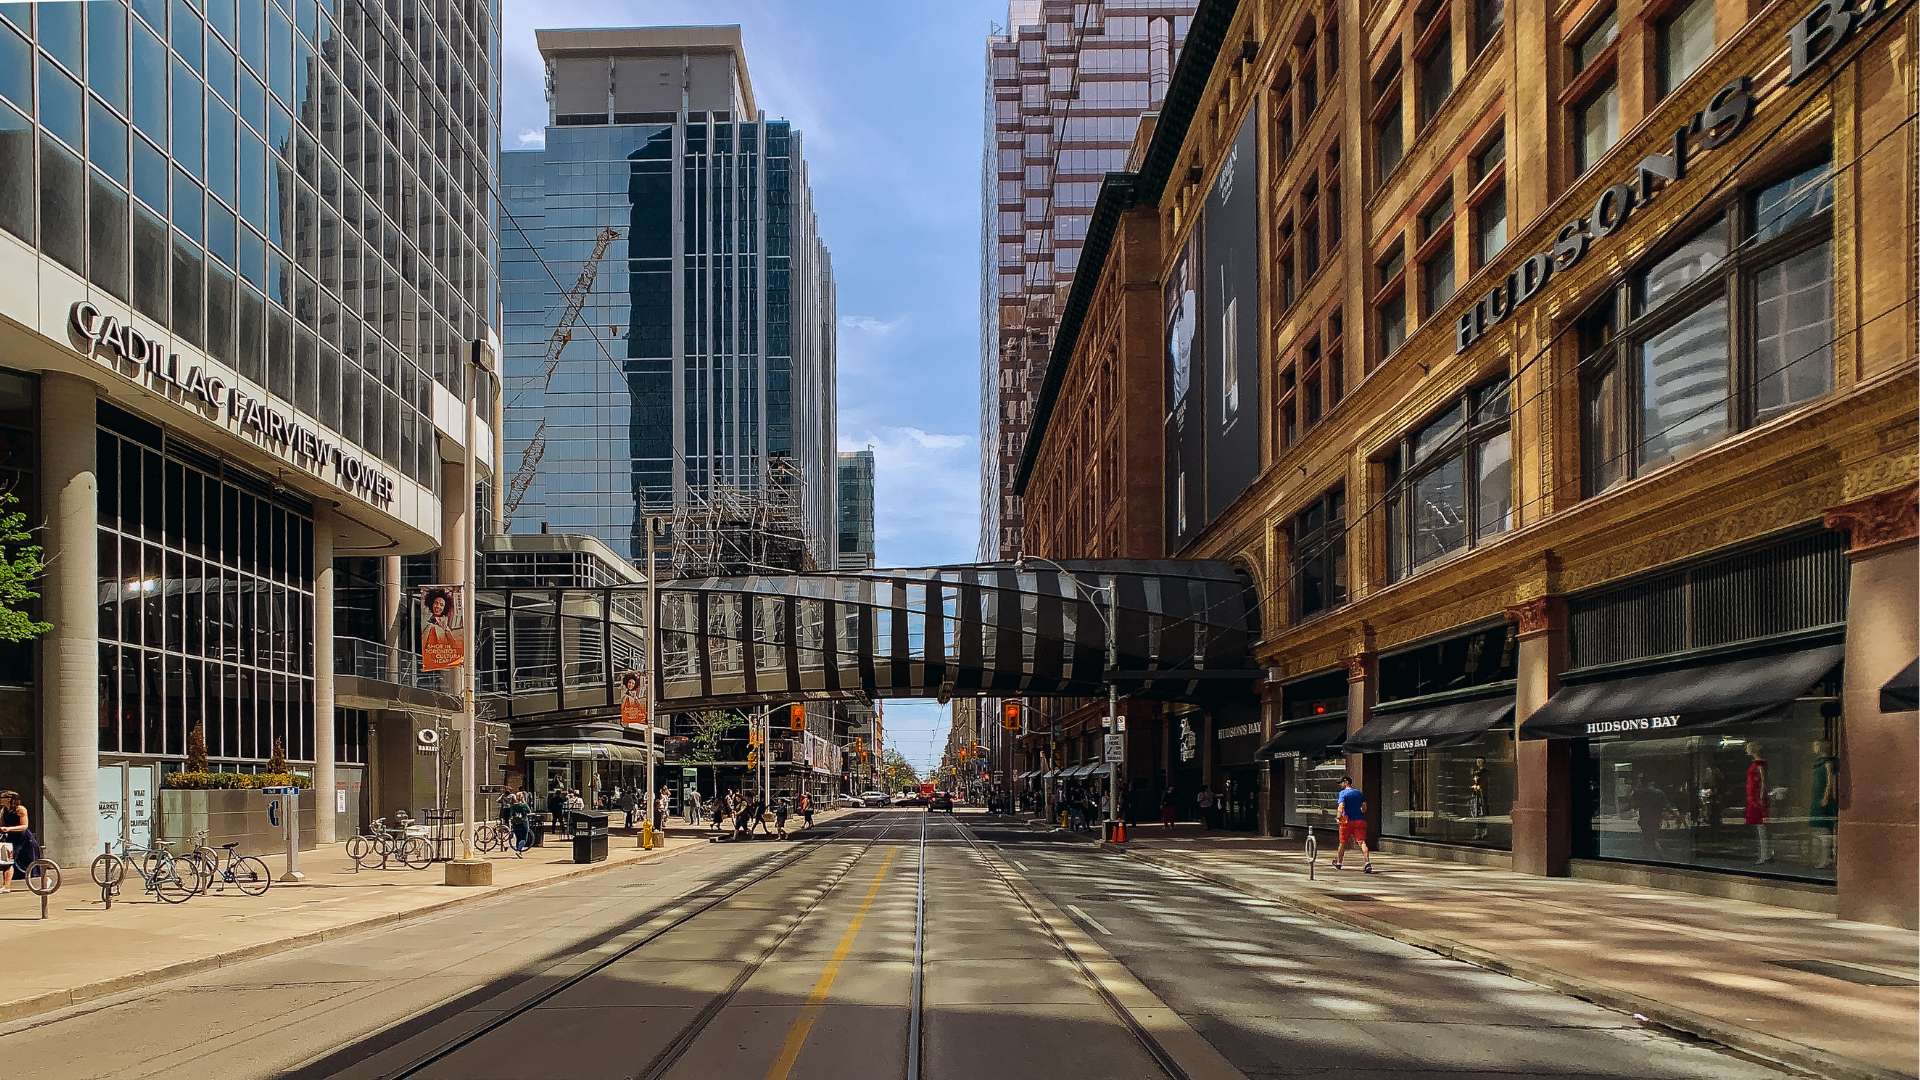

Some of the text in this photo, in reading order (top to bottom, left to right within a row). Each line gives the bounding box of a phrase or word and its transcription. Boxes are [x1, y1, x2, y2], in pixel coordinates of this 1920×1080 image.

[1455, 75, 1755, 354] HUDSON'S
[69, 300, 395, 503] CADILLAC FAIRVIEW TOWER
[1248, 721, 1262, 735] BAY
[1586, 715, 1680, 734] HUDSON'S BAY
[1383, 738, 1428, 750] HUDSON'S BAY
